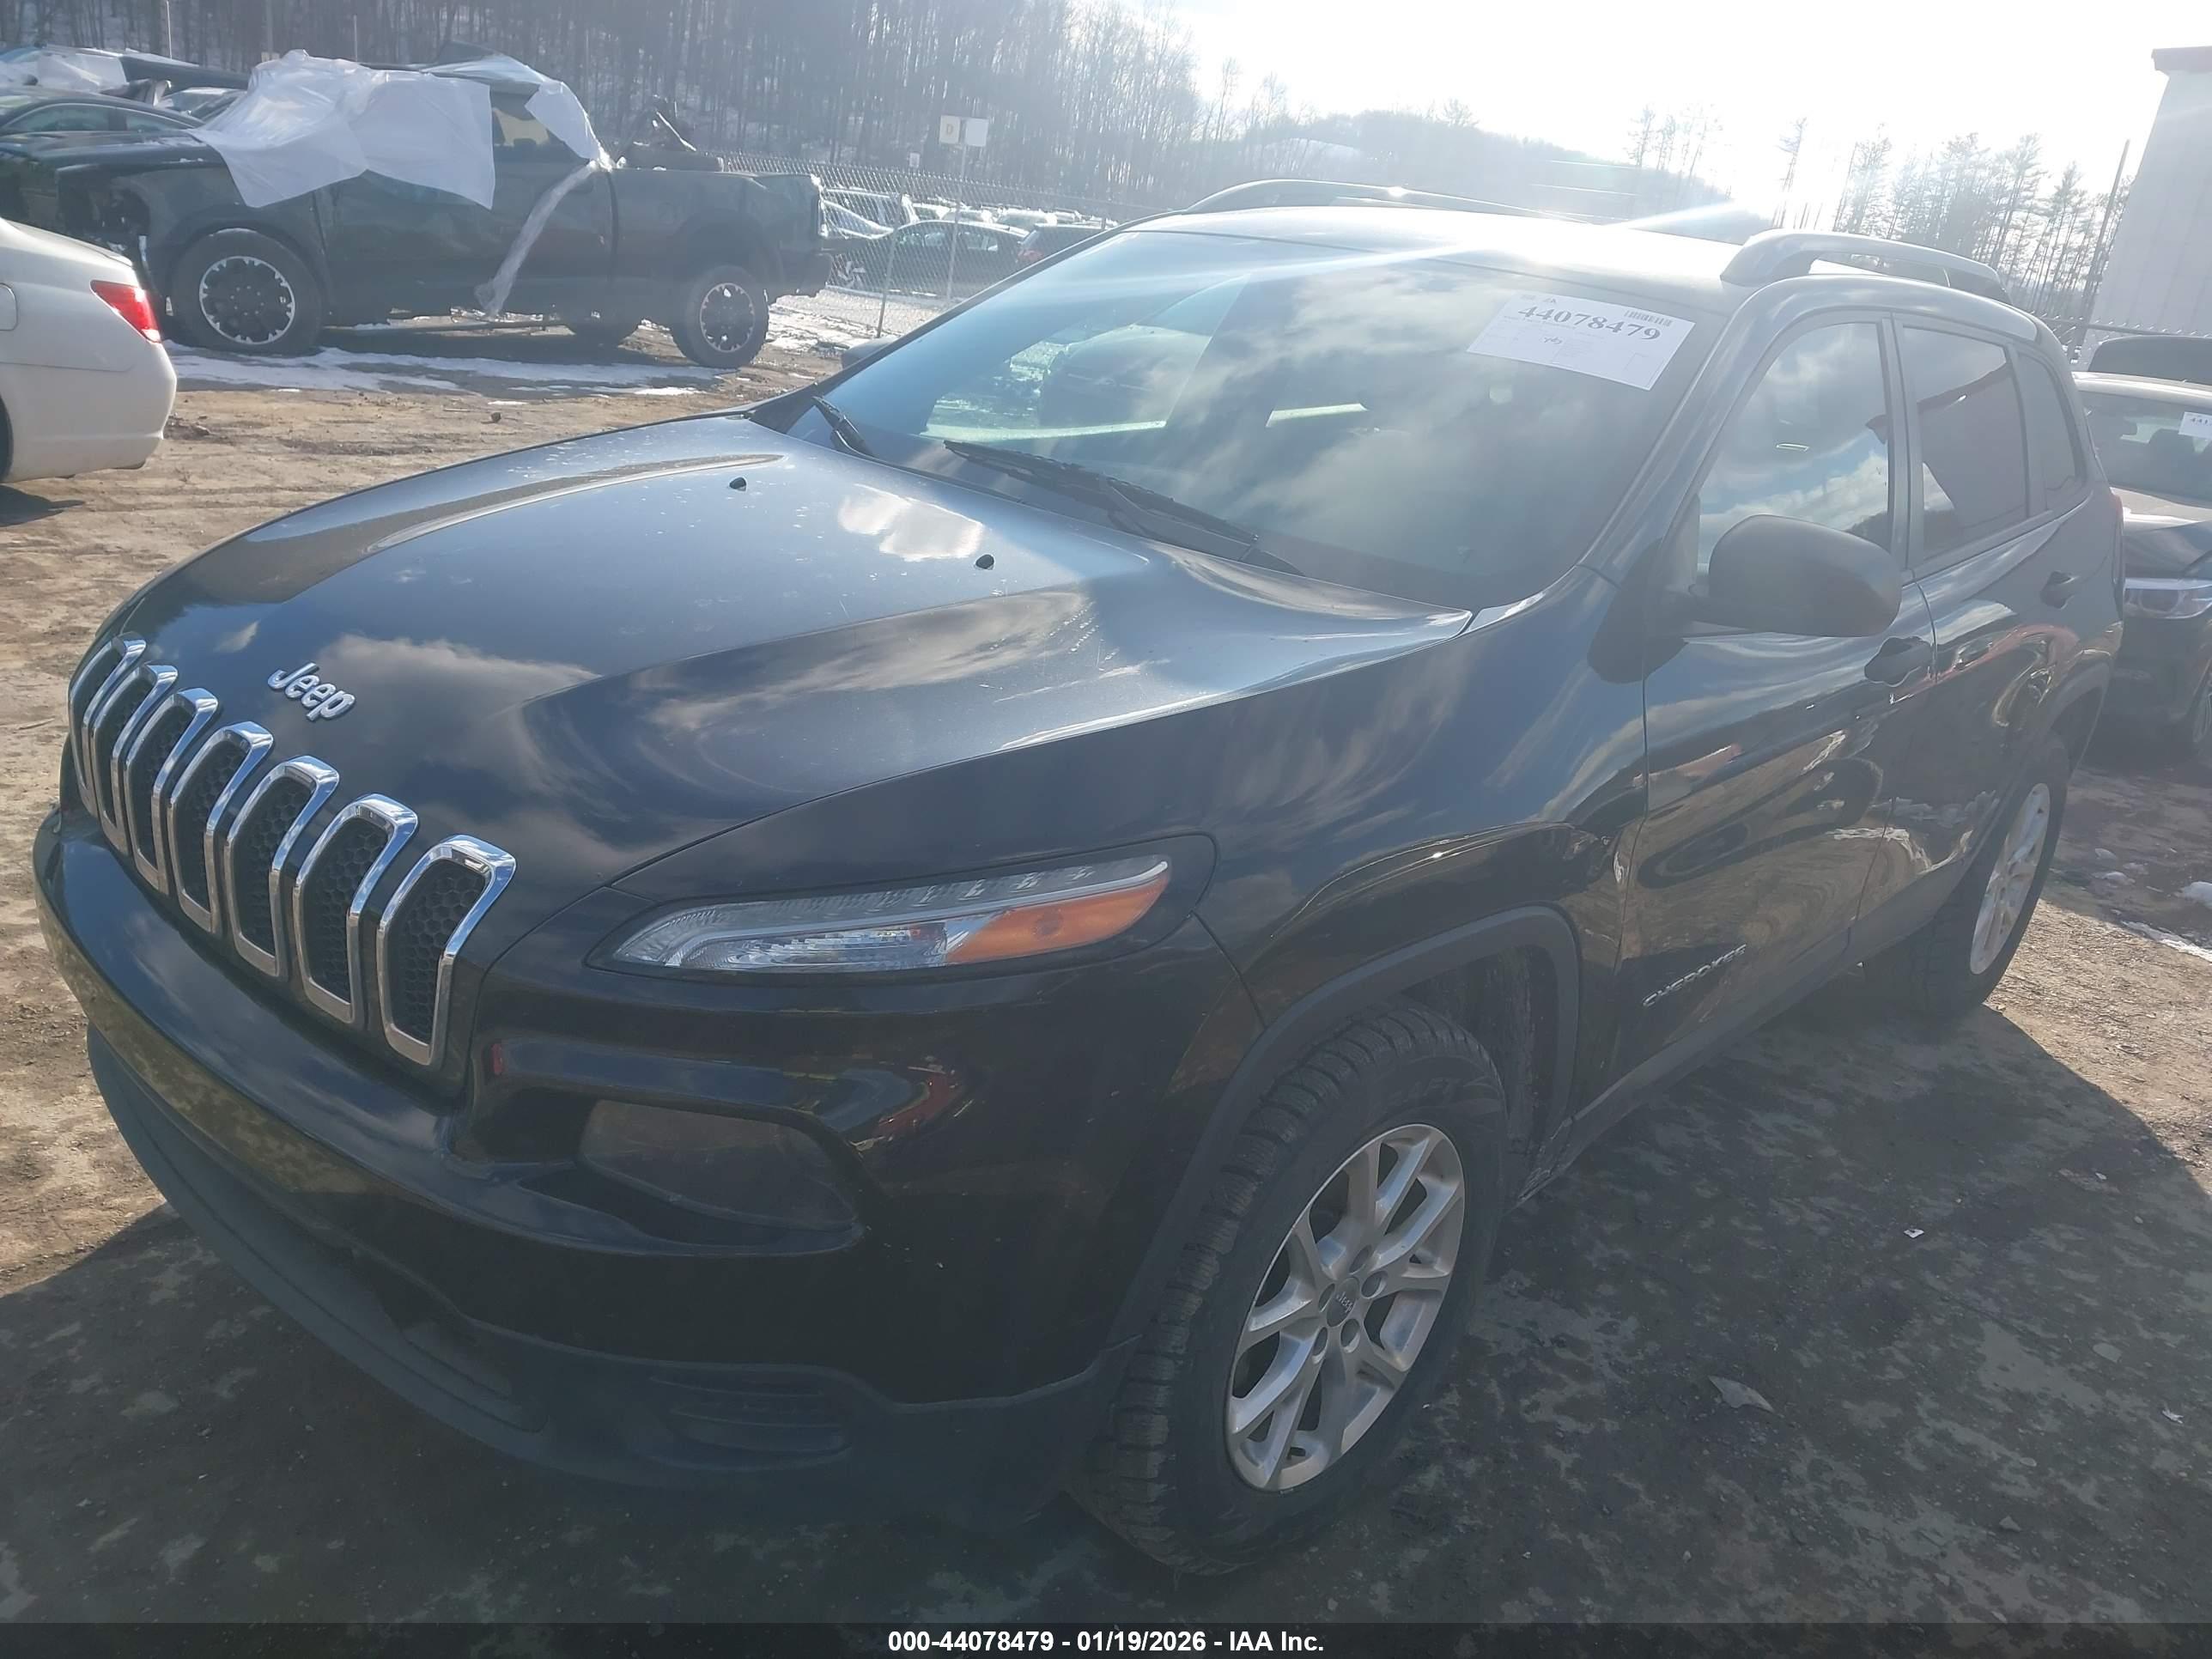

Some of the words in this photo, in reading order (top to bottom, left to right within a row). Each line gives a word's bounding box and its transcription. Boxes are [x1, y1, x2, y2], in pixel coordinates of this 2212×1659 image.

[1517, 306, 1662, 341] 44078479
[267, 662, 356, 721] Jeep
[1641, 943, 1747, 1006] CHEROKEE
